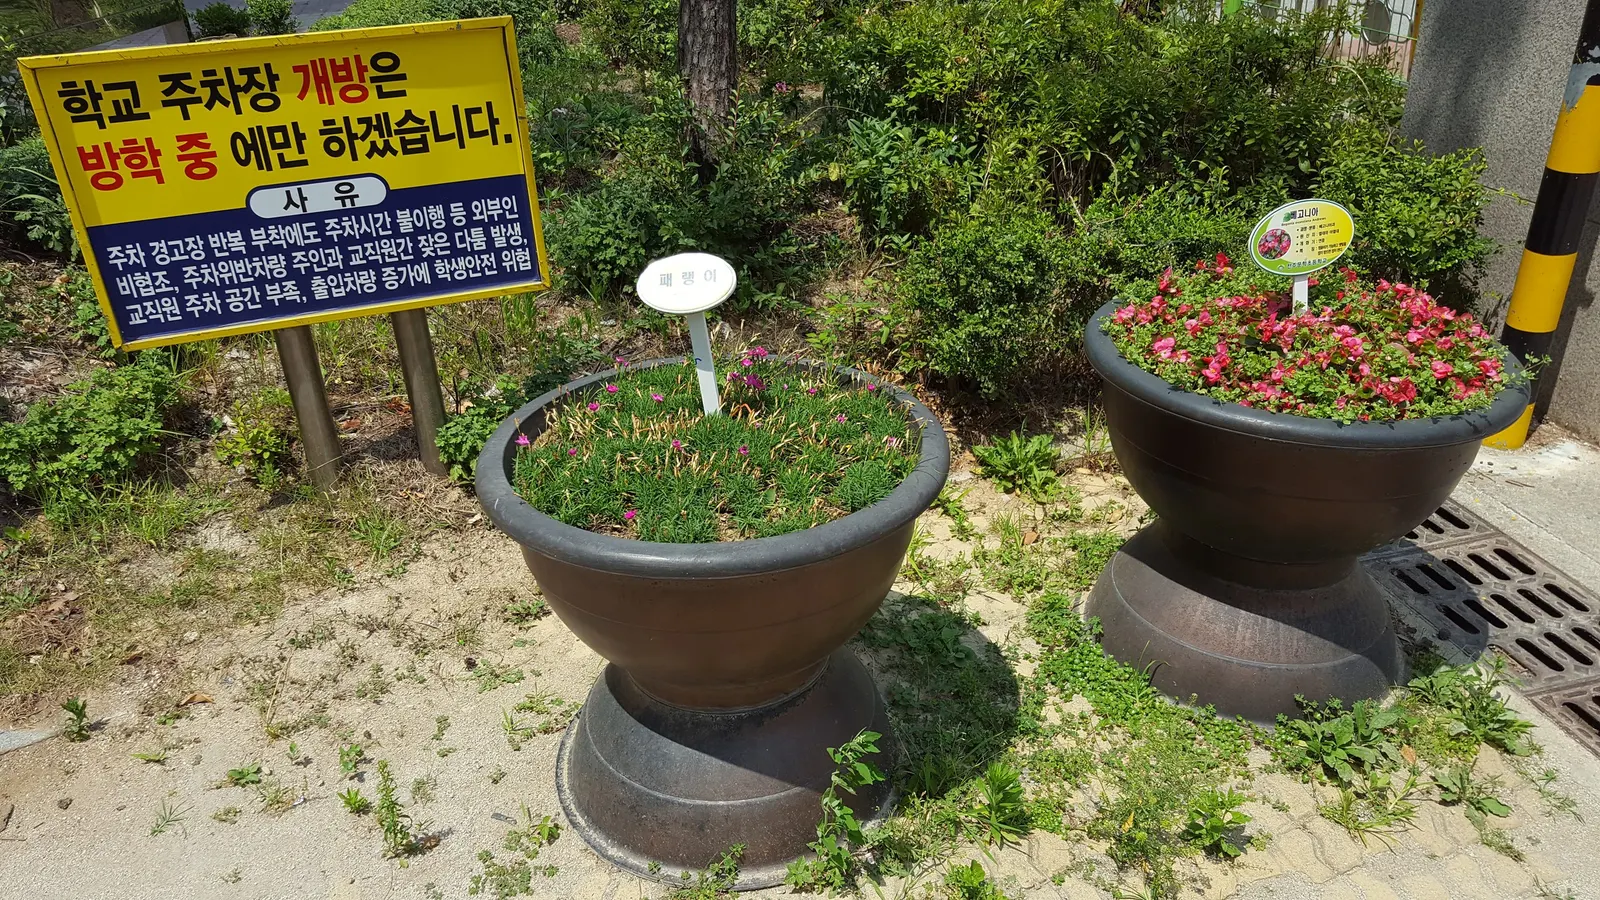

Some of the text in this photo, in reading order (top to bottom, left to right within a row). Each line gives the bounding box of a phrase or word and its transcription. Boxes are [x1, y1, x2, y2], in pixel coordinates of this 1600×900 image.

[57, 51, 407, 130] 학교 주차장 개방은
[76, 101, 513, 191] 방학 중 에만 하겠습니다.
[106, 195, 519, 271] 주차 경고장 반복 부착에도 주차시간 불이행 등 외부인
[116, 222, 528, 298] 비협조, 주차위반차량 주인과 교직원간 잦은 다툼 발생,
[125, 247, 532, 325] 교직원 주차 공간 부족, 출입차량 증가에 학생안전 위협
